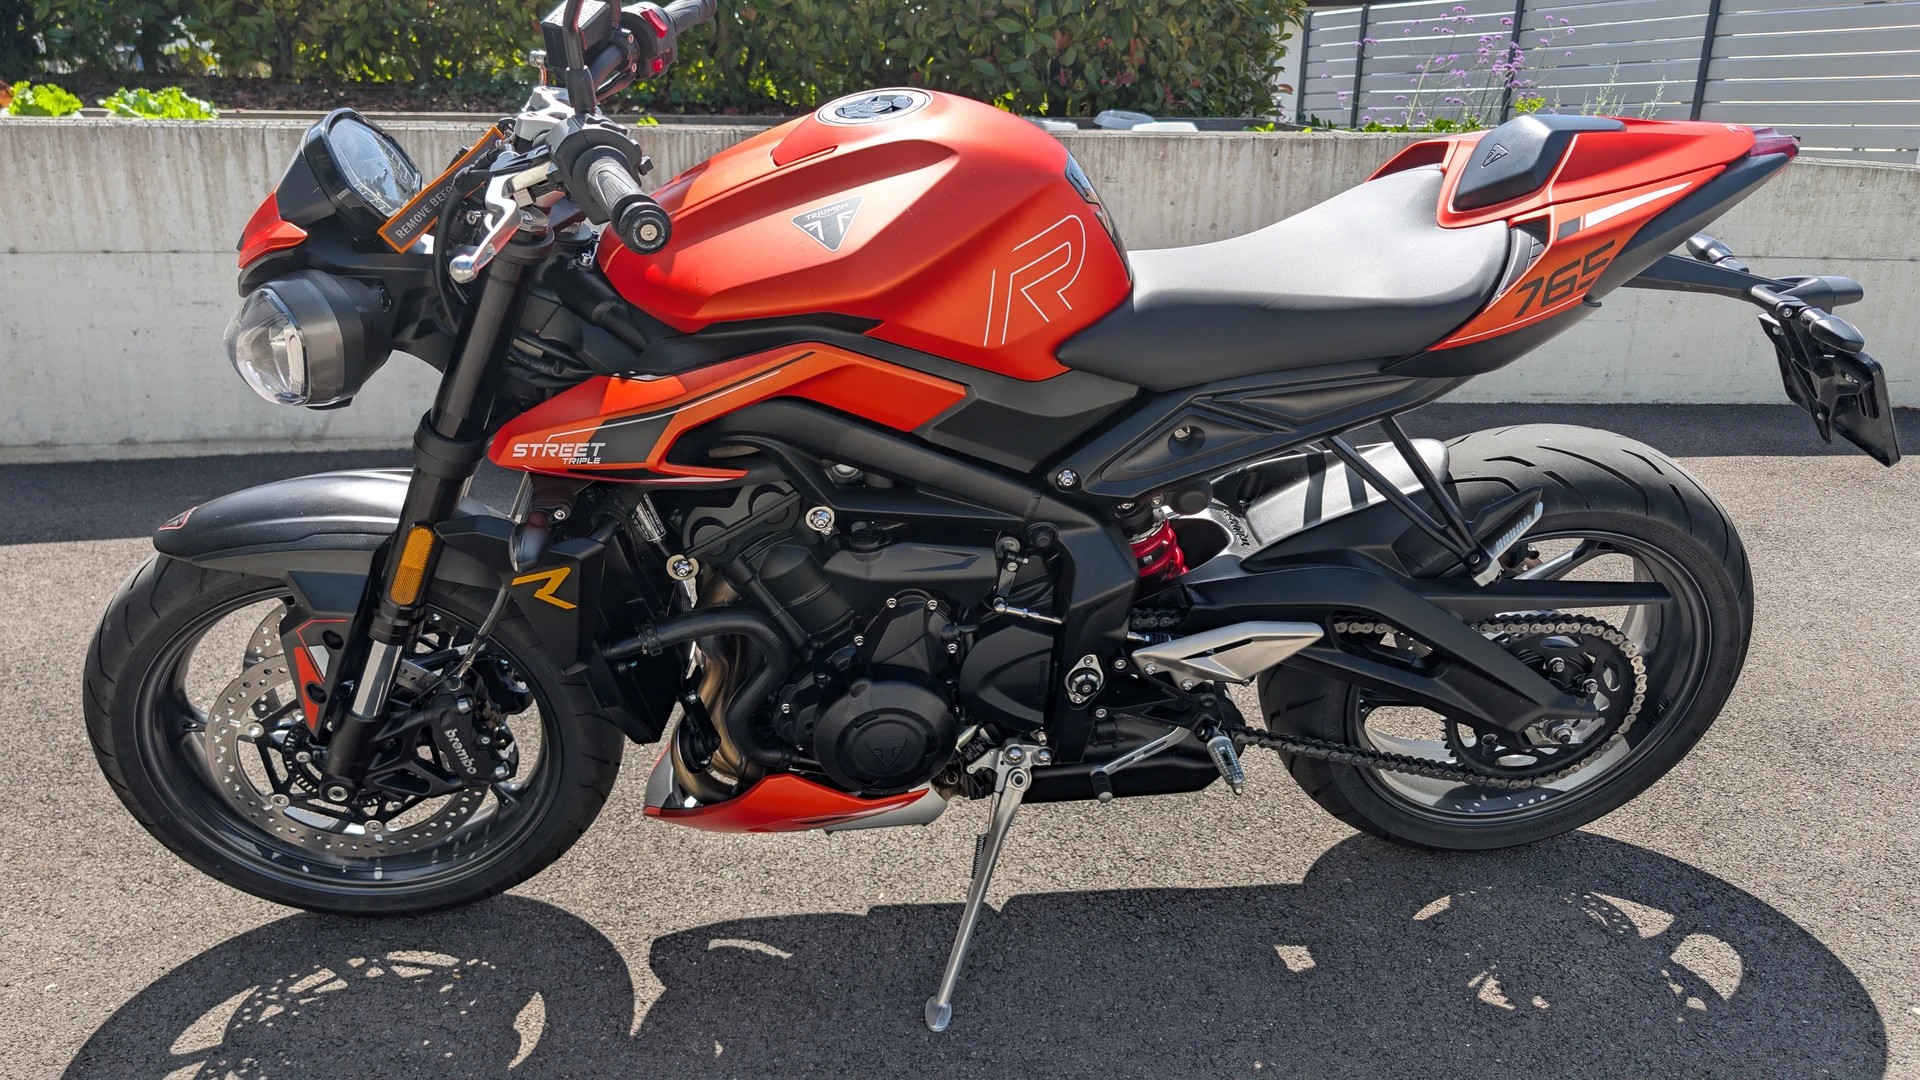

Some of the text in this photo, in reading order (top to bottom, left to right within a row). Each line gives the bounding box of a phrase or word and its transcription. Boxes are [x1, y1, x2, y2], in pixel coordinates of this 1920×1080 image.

[395, 185, 453, 239] REMOVE BEFO
[804, 202, 849, 221] TRIUMPH
[1513, 239, 1616, 319] 765
[512, 442, 606, 458] STREET
[562, 457, 602, 465] TRIPLE
[444, 728, 478, 775] brembo
